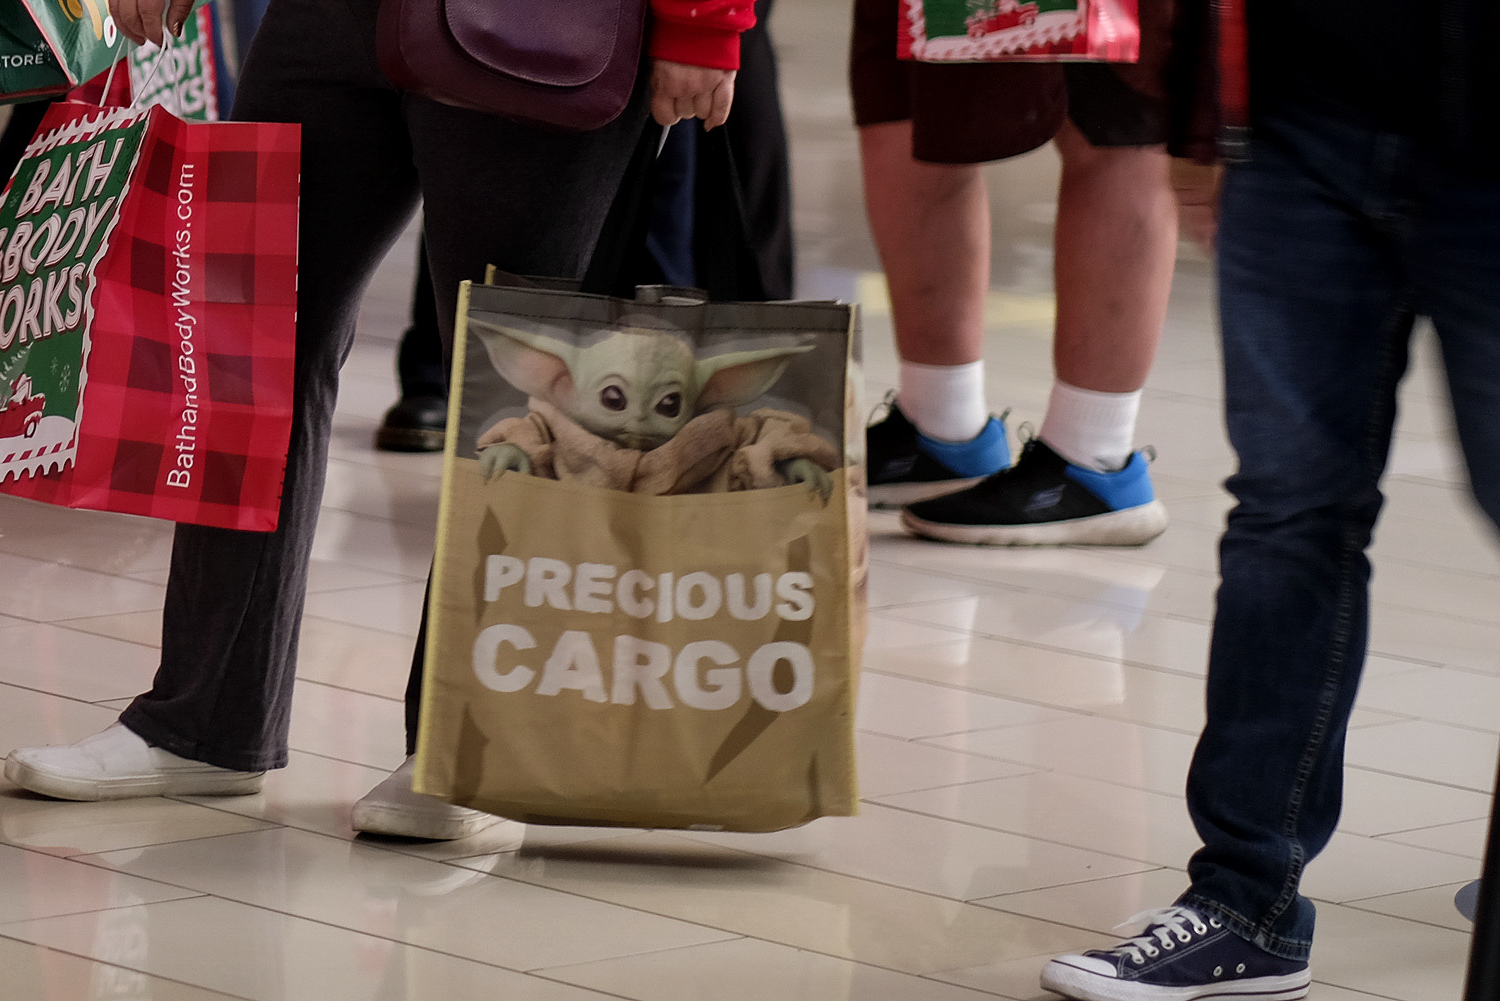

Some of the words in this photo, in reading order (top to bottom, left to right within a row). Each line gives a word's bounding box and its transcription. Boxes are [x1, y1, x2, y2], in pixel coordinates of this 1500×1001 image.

[16, 137, 125, 219] BATH
[166, 163, 196, 489] BathandBodyWorks.com
[483, 554, 815, 623] PRECIOUS
[472, 623, 815, 713] CARGO
